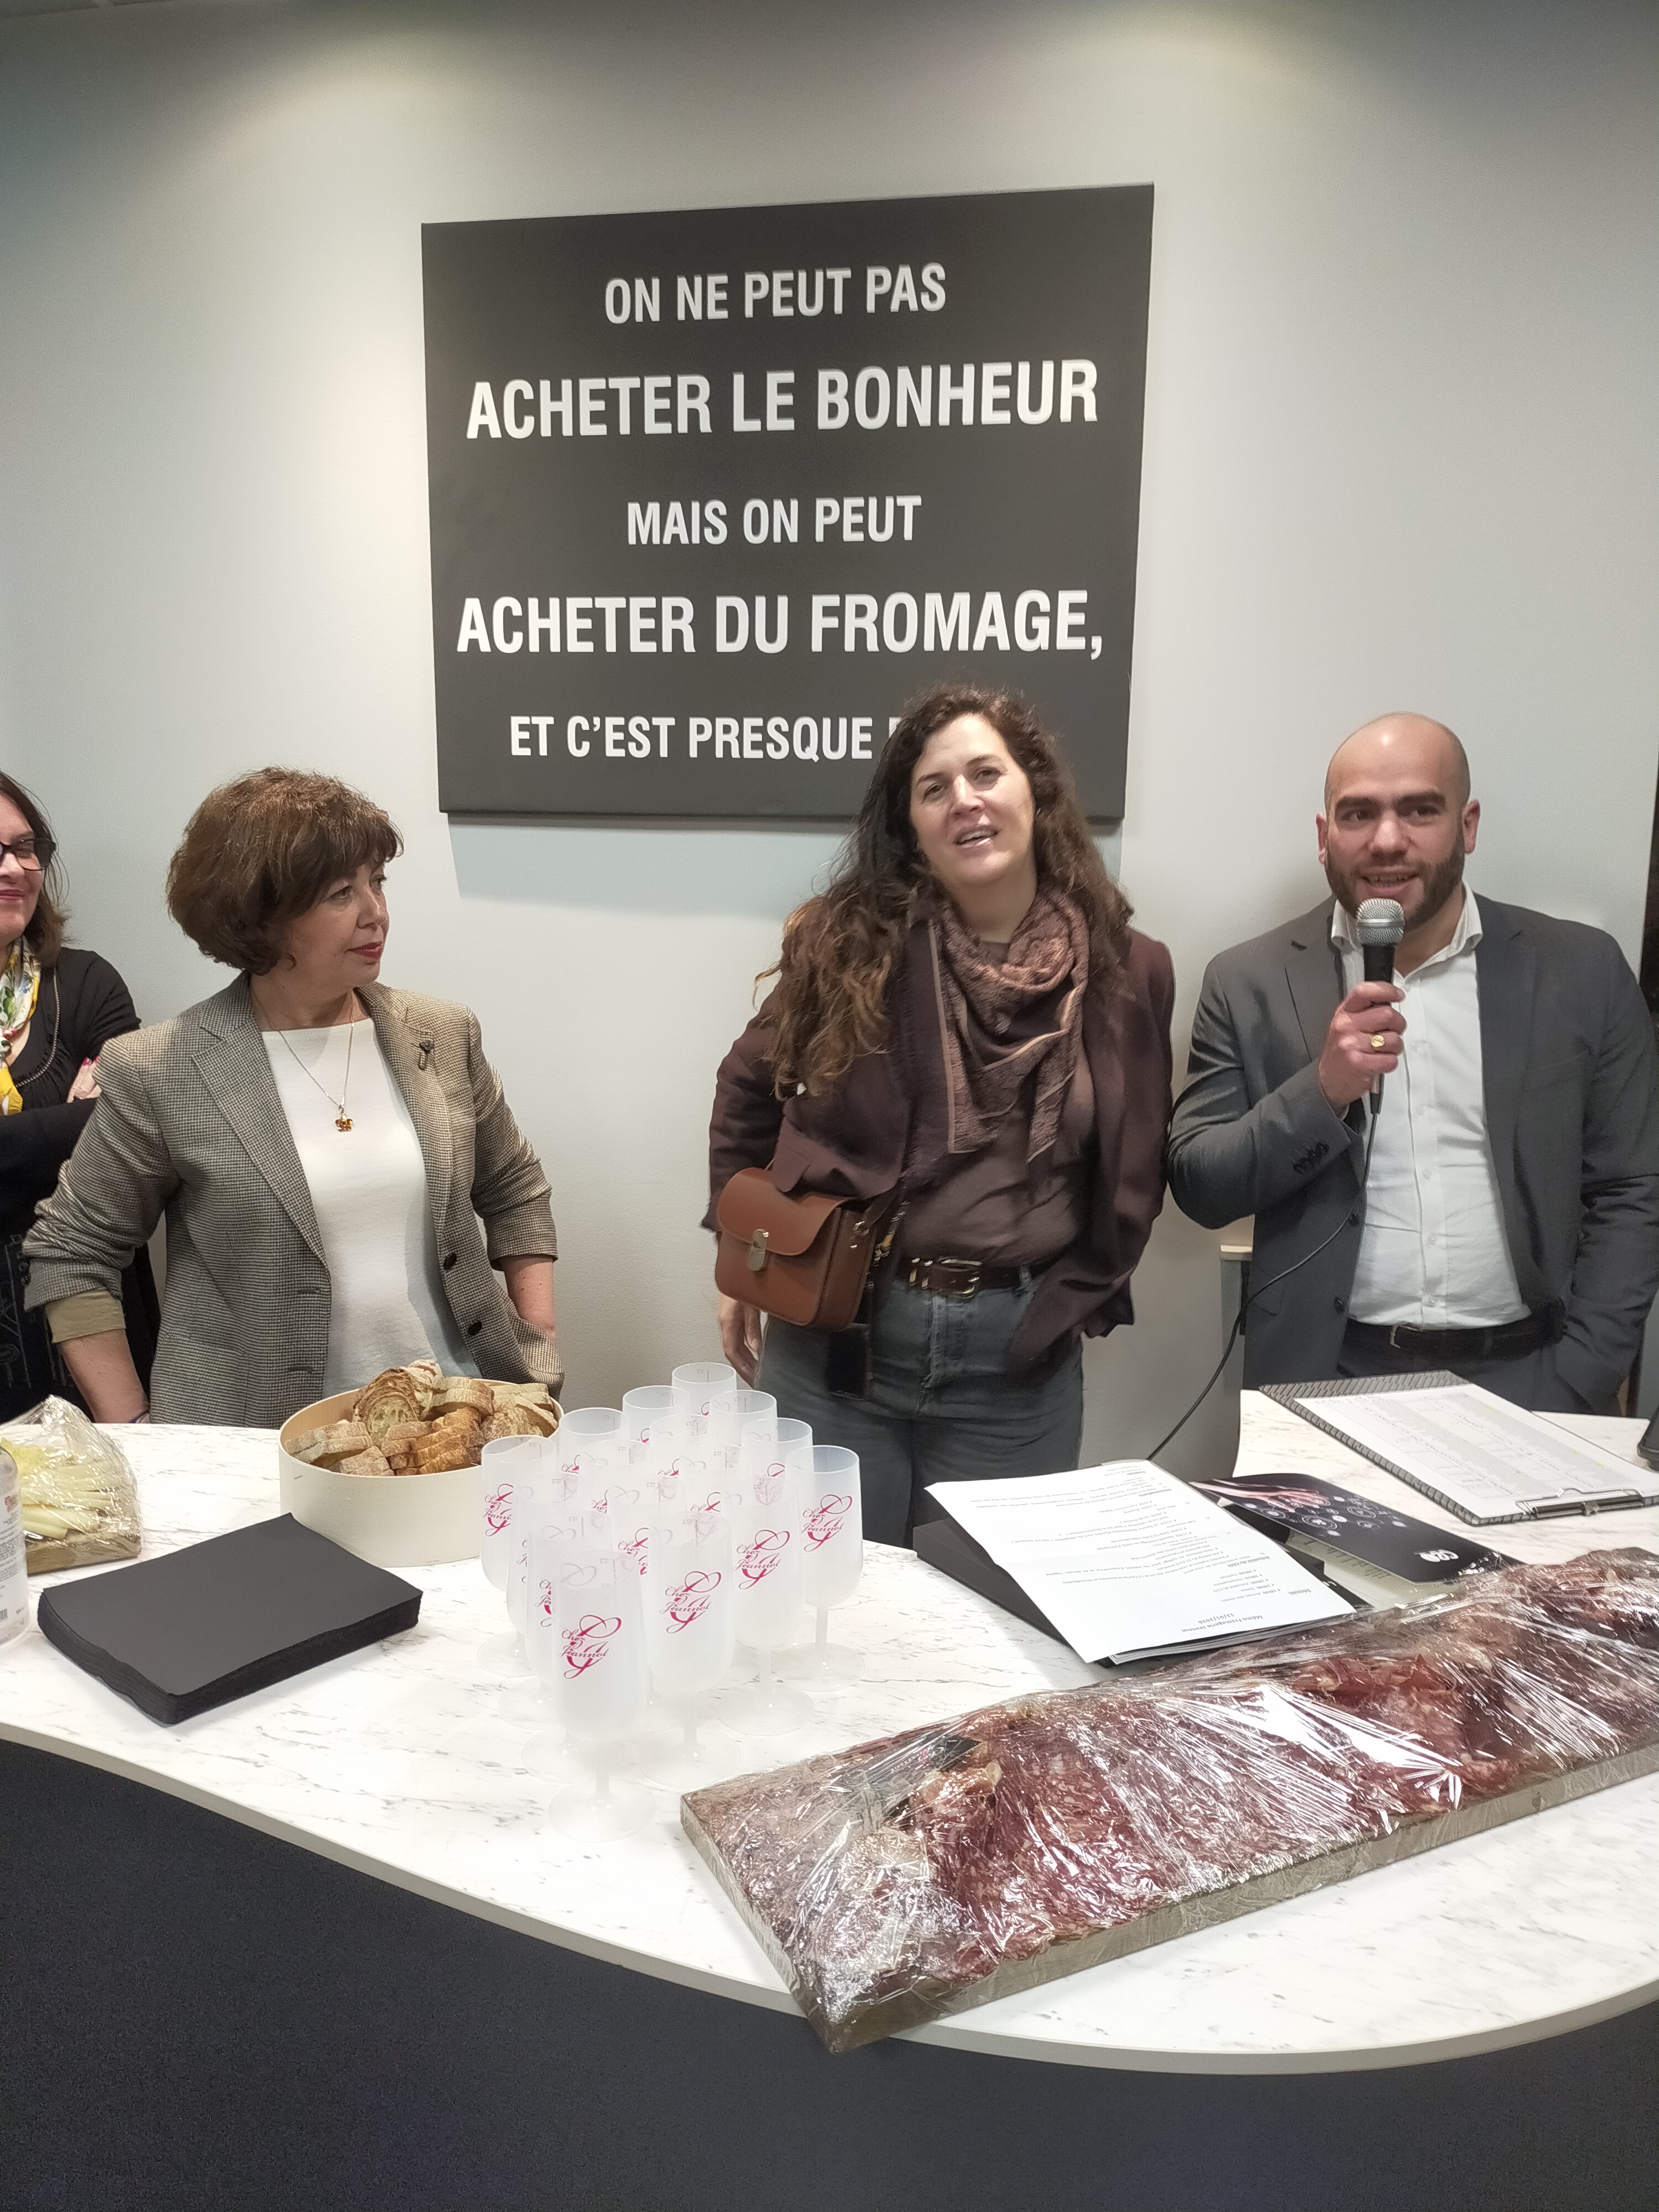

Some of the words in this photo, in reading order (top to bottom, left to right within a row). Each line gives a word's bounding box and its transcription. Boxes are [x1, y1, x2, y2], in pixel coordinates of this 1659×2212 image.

[605, 278, 660, 324] ON
[677, 275, 728, 321] NE
[745, 268, 852, 318] PEUT
[867, 263, 946, 313] PAS
[466, 375, 712, 439] ACHETER
[733, 371, 795, 432] LE
[817, 359, 1098, 430] BONHEUR
[628, 500, 728, 545] MAIS
[743, 498, 799, 544] ON
[815, 495, 922, 542] PEUT
[457, 596, 696, 654] ACHETER
[716, 595, 789, 654] DU
[811, 589, 1102, 660] FROMAGE,
[510, 716, 554, 756] ET
[689, 716, 873, 763] PRESQUE
[802, 1507, 826, 1525] Chez
[801, 1522, 844, 1534] Jeannot
[736, 1543, 761, 1562] Chez
[732, 1558, 781, 1572] Jeannot
[665, 1584, 690, 1605] Chez
[659, 1601, 712, 1614] Jeannot
[1207, 1619, 1242, 1628] Fromagerie
[561, 1627, 586, 1650] Chez
[557, 1645, 609, 1658] Jeannot
